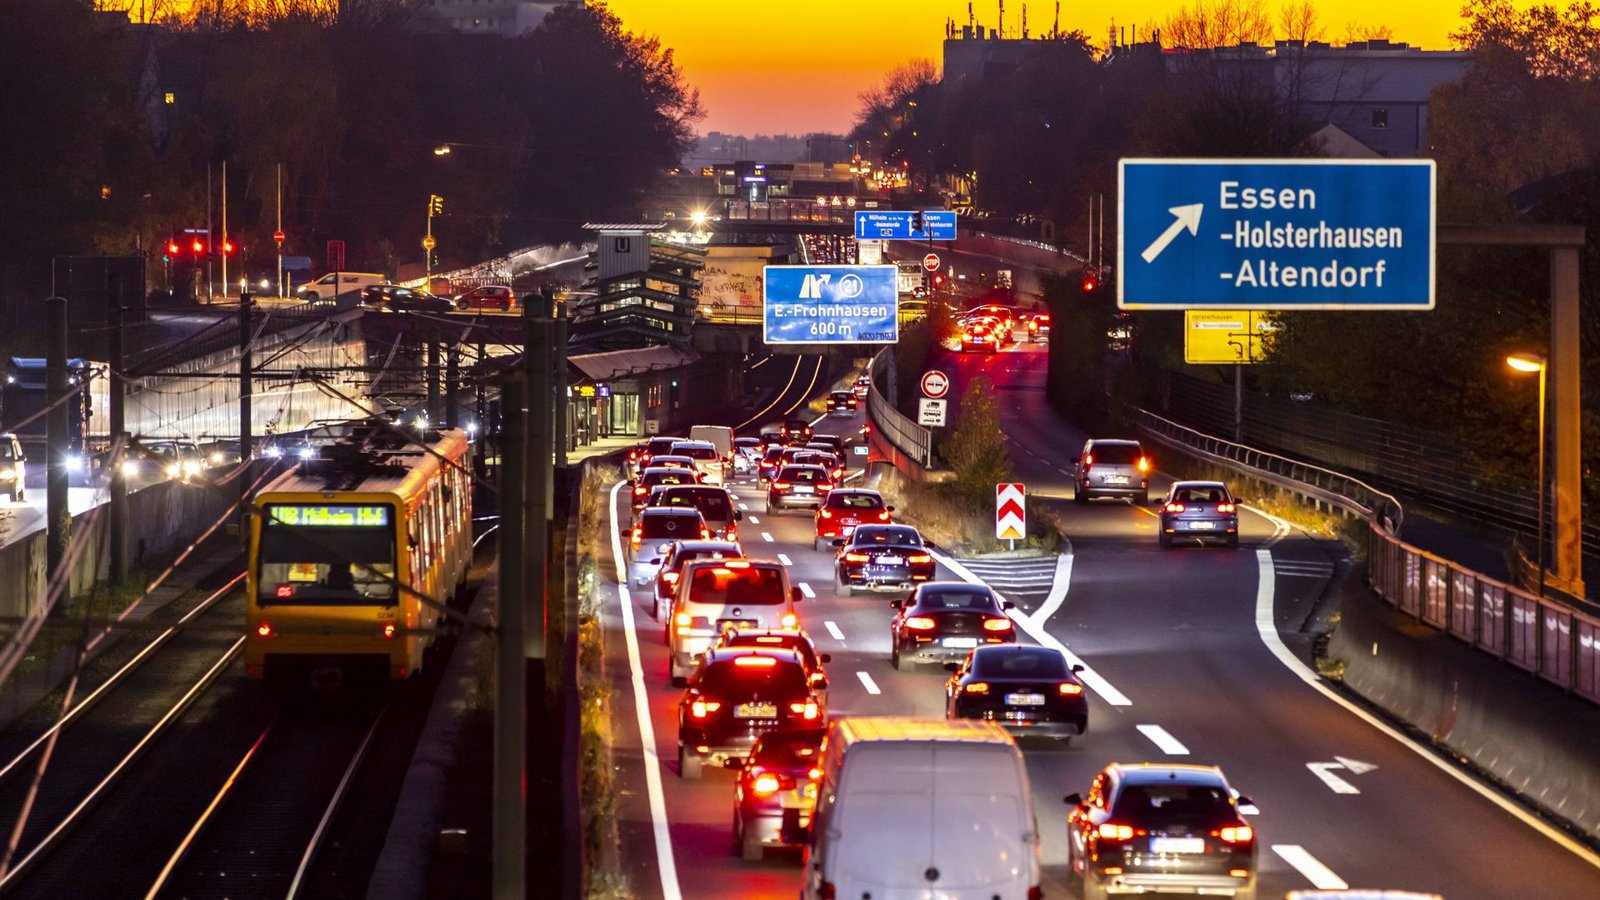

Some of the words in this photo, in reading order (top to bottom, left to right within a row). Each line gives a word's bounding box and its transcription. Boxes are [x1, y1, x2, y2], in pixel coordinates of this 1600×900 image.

[1220, 181, 1316, 209] Essen
[1220, 220, 1403, 248] -Holsterhausen
[617, 238, 629, 250] U
[1220, 259, 1386, 287] -Altendorf
[842, 279, 858, 291] 21
[774, 304, 887, 317] E.-Frohnhausen
[810, 322, 836, 335] 600
[838, 324, 852, 335] m
